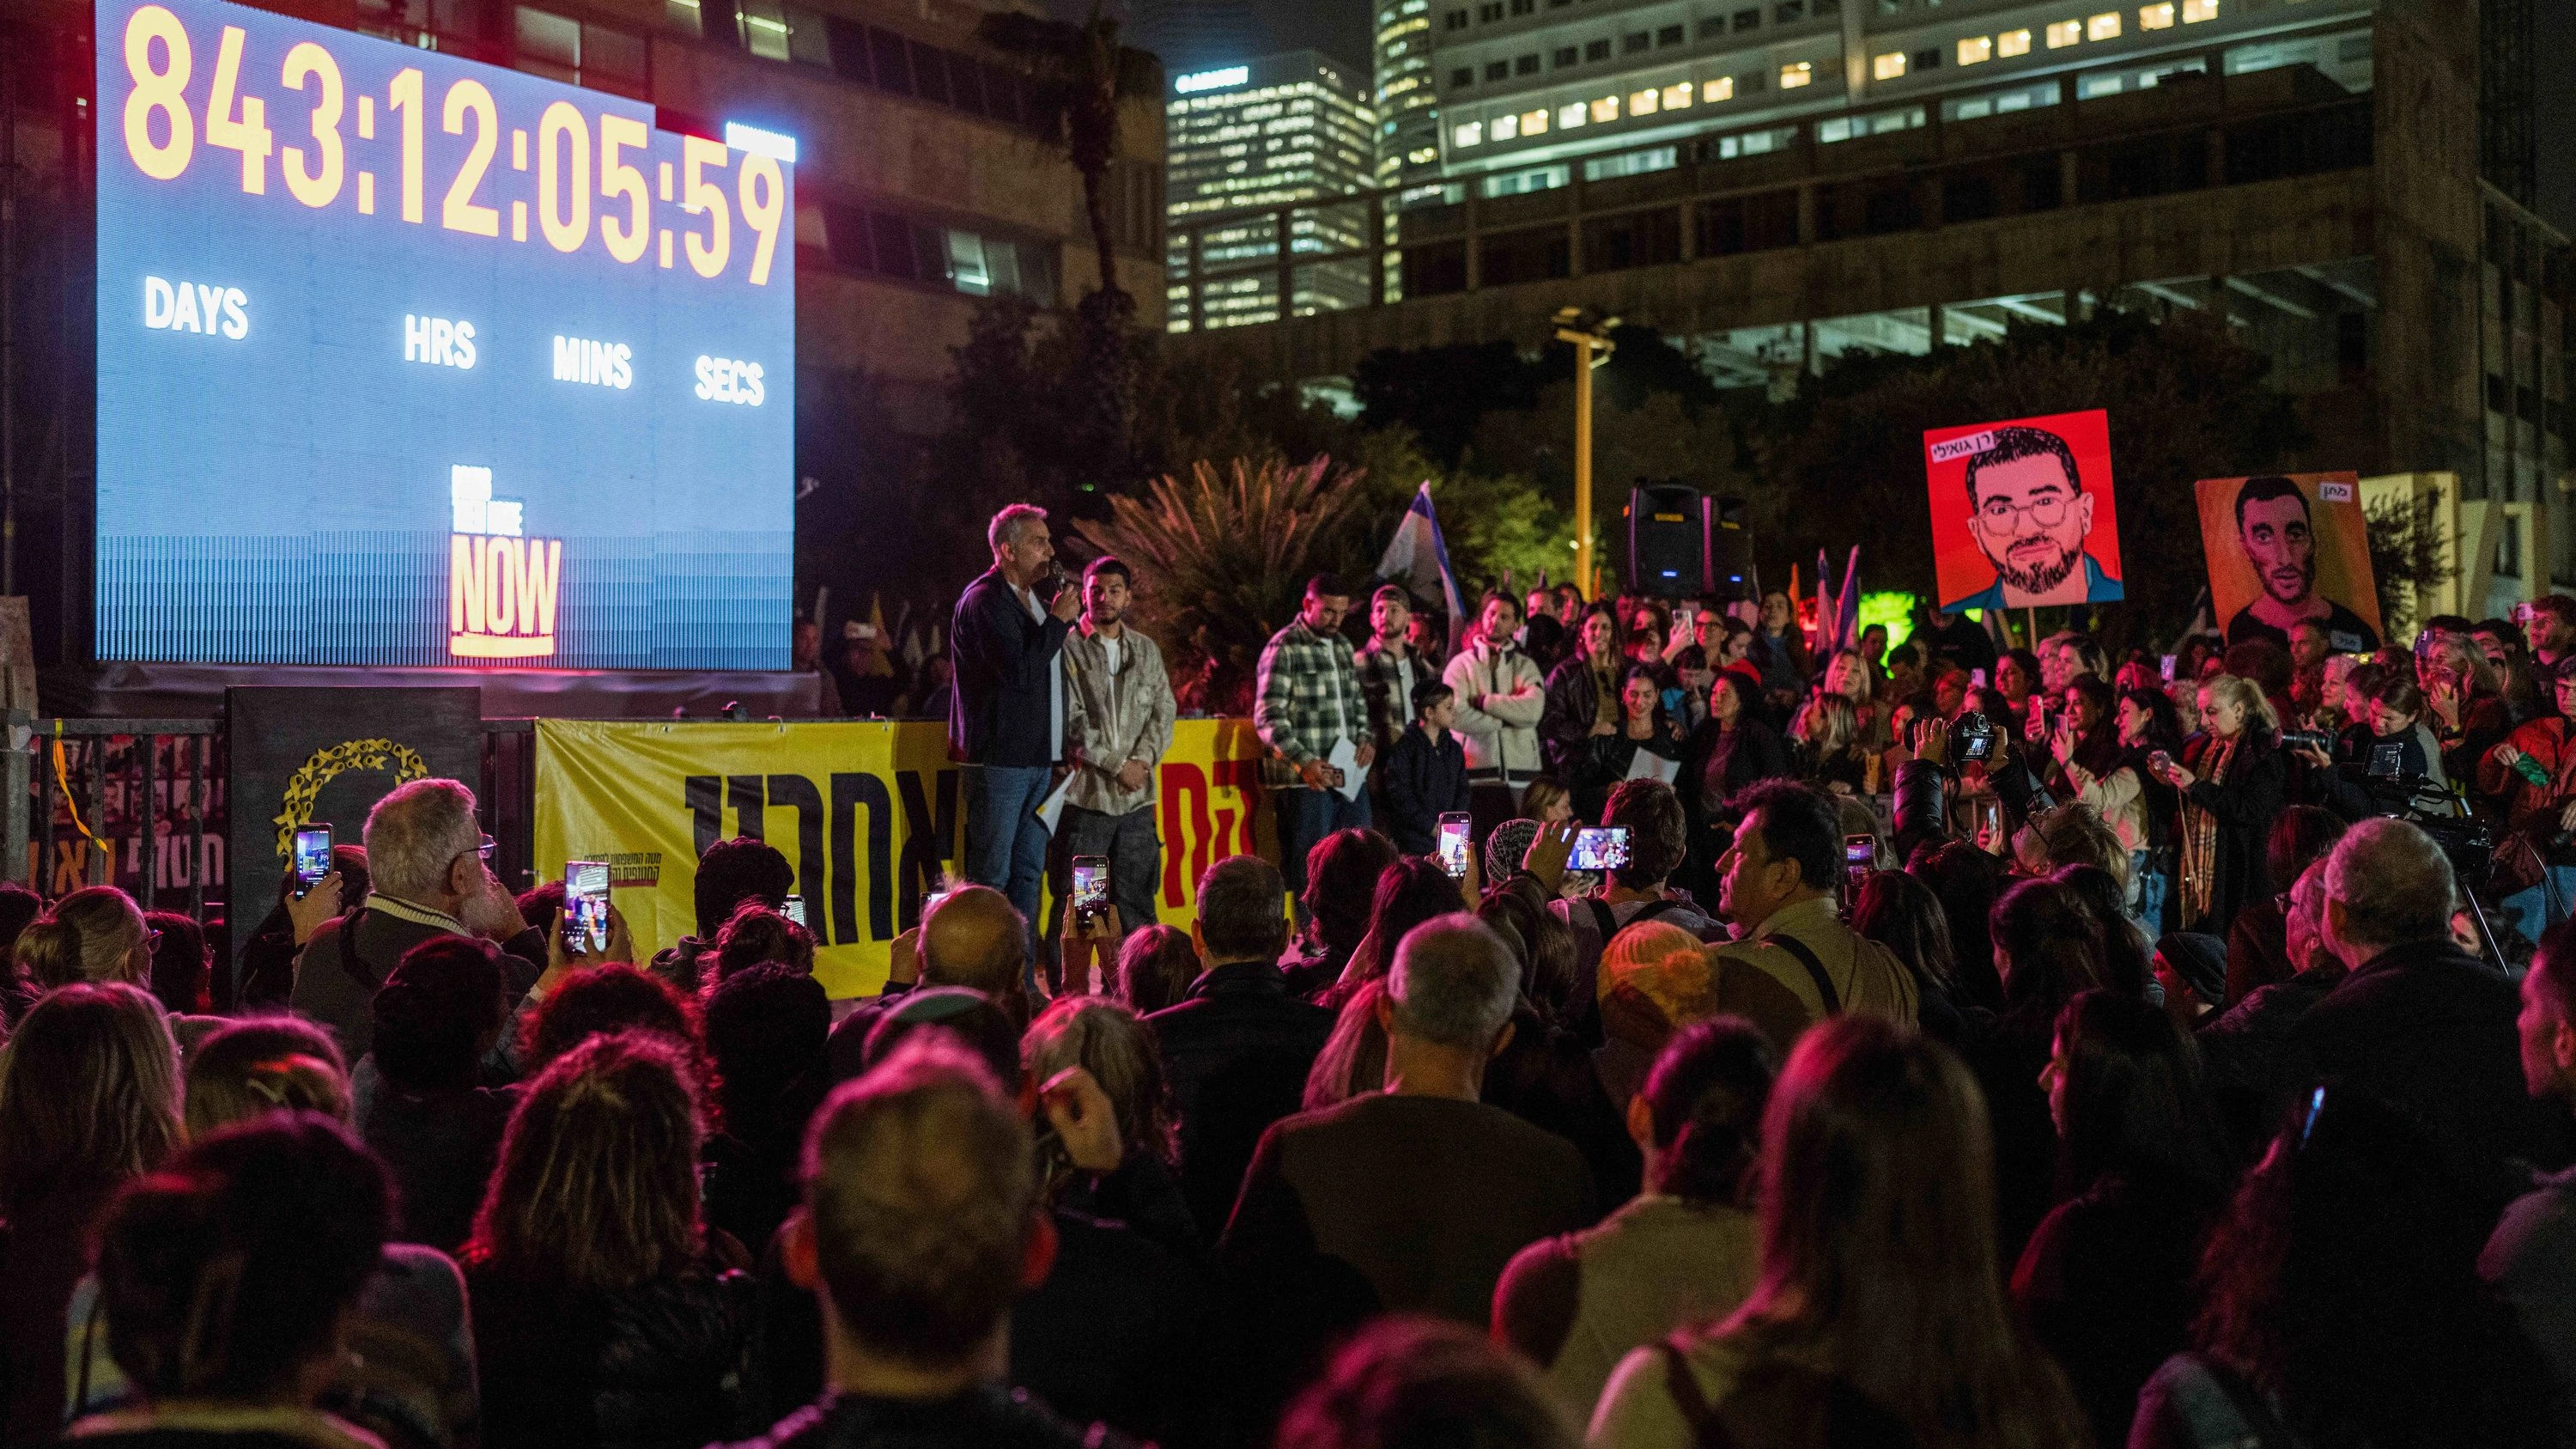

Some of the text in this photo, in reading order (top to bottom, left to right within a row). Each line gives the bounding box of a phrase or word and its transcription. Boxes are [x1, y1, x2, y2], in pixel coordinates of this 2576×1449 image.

[124, 5, 785, 286] 843:12:05:59
[145, 275, 764, 407] DAYS HRS MINS SECS
[1934, 434, 1990, 459] רן גואילי
[451, 534, 562, 635] NOW
[646, 852, 662, 864] מטה
